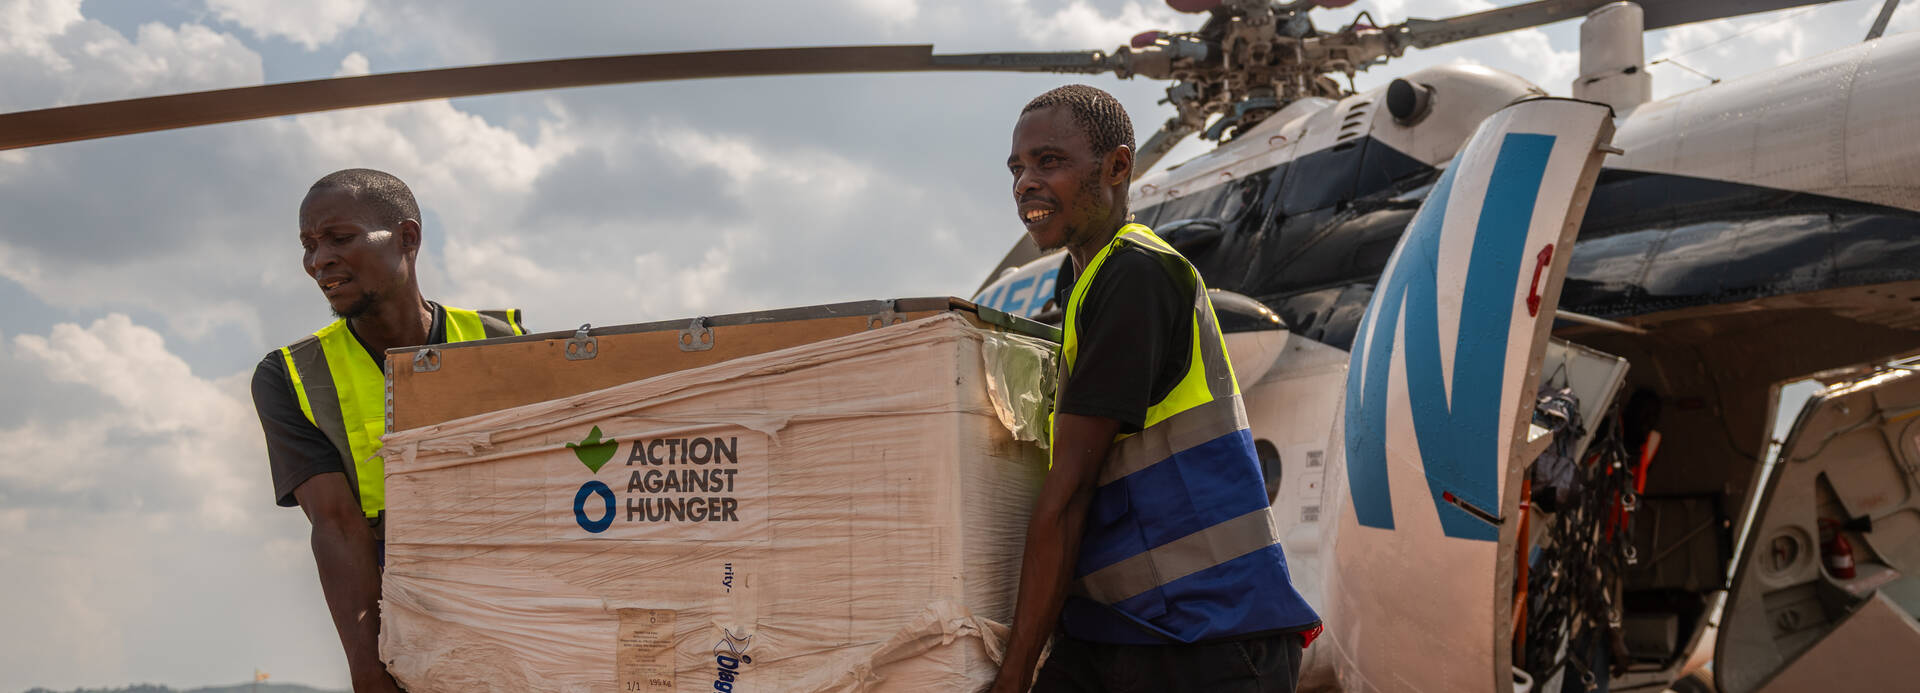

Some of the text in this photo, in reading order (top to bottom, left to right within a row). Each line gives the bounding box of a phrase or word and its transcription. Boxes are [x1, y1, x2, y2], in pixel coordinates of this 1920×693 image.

[626, 437, 738, 466] ACTION
[627, 468, 738, 493] AGAINST
[626, 496, 739, 522] HUNGER
[626, 680, 641, 692] 1/1
[713, 655, 739, 693] Diag
